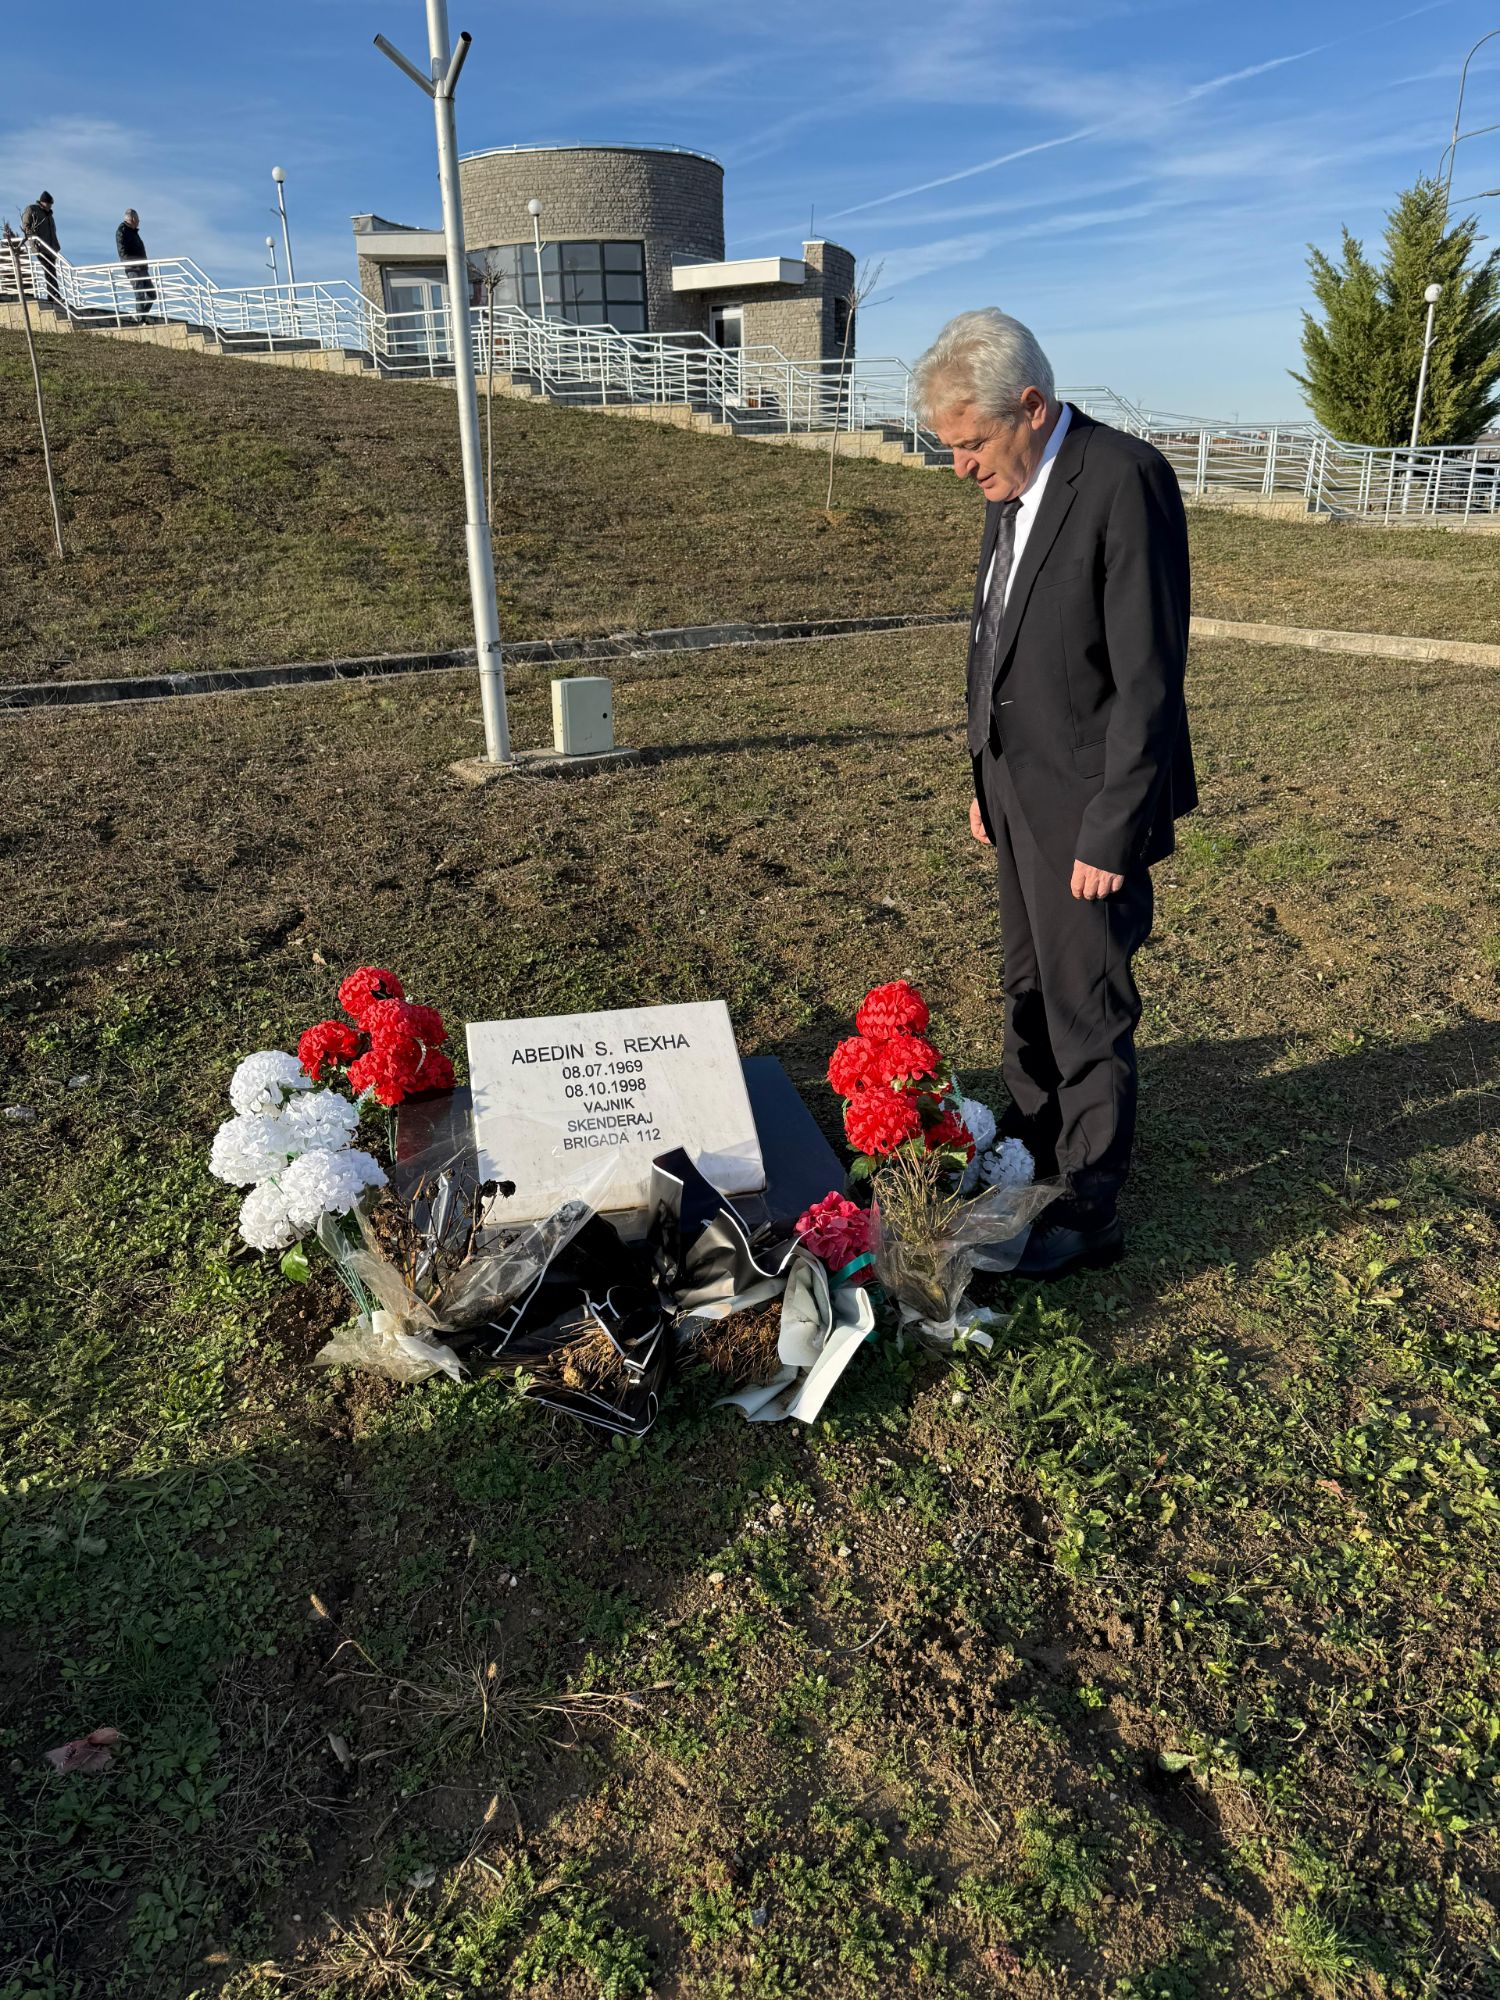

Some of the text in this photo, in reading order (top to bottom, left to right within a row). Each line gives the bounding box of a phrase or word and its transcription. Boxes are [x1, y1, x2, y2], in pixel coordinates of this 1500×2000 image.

[511, 1033, 690, 1065] ABEDIN S. REXHA
[562, 1060, 643, 1080] 08.07.1969
[565, 1078, 647, 1098] 08.10.1998
[584, 1098, 635, 1114] VAJNIK
[567, 1112, 653, 1132] SKENDERAJ
[563, 1128, 661, 1150] BRIGADA 112
